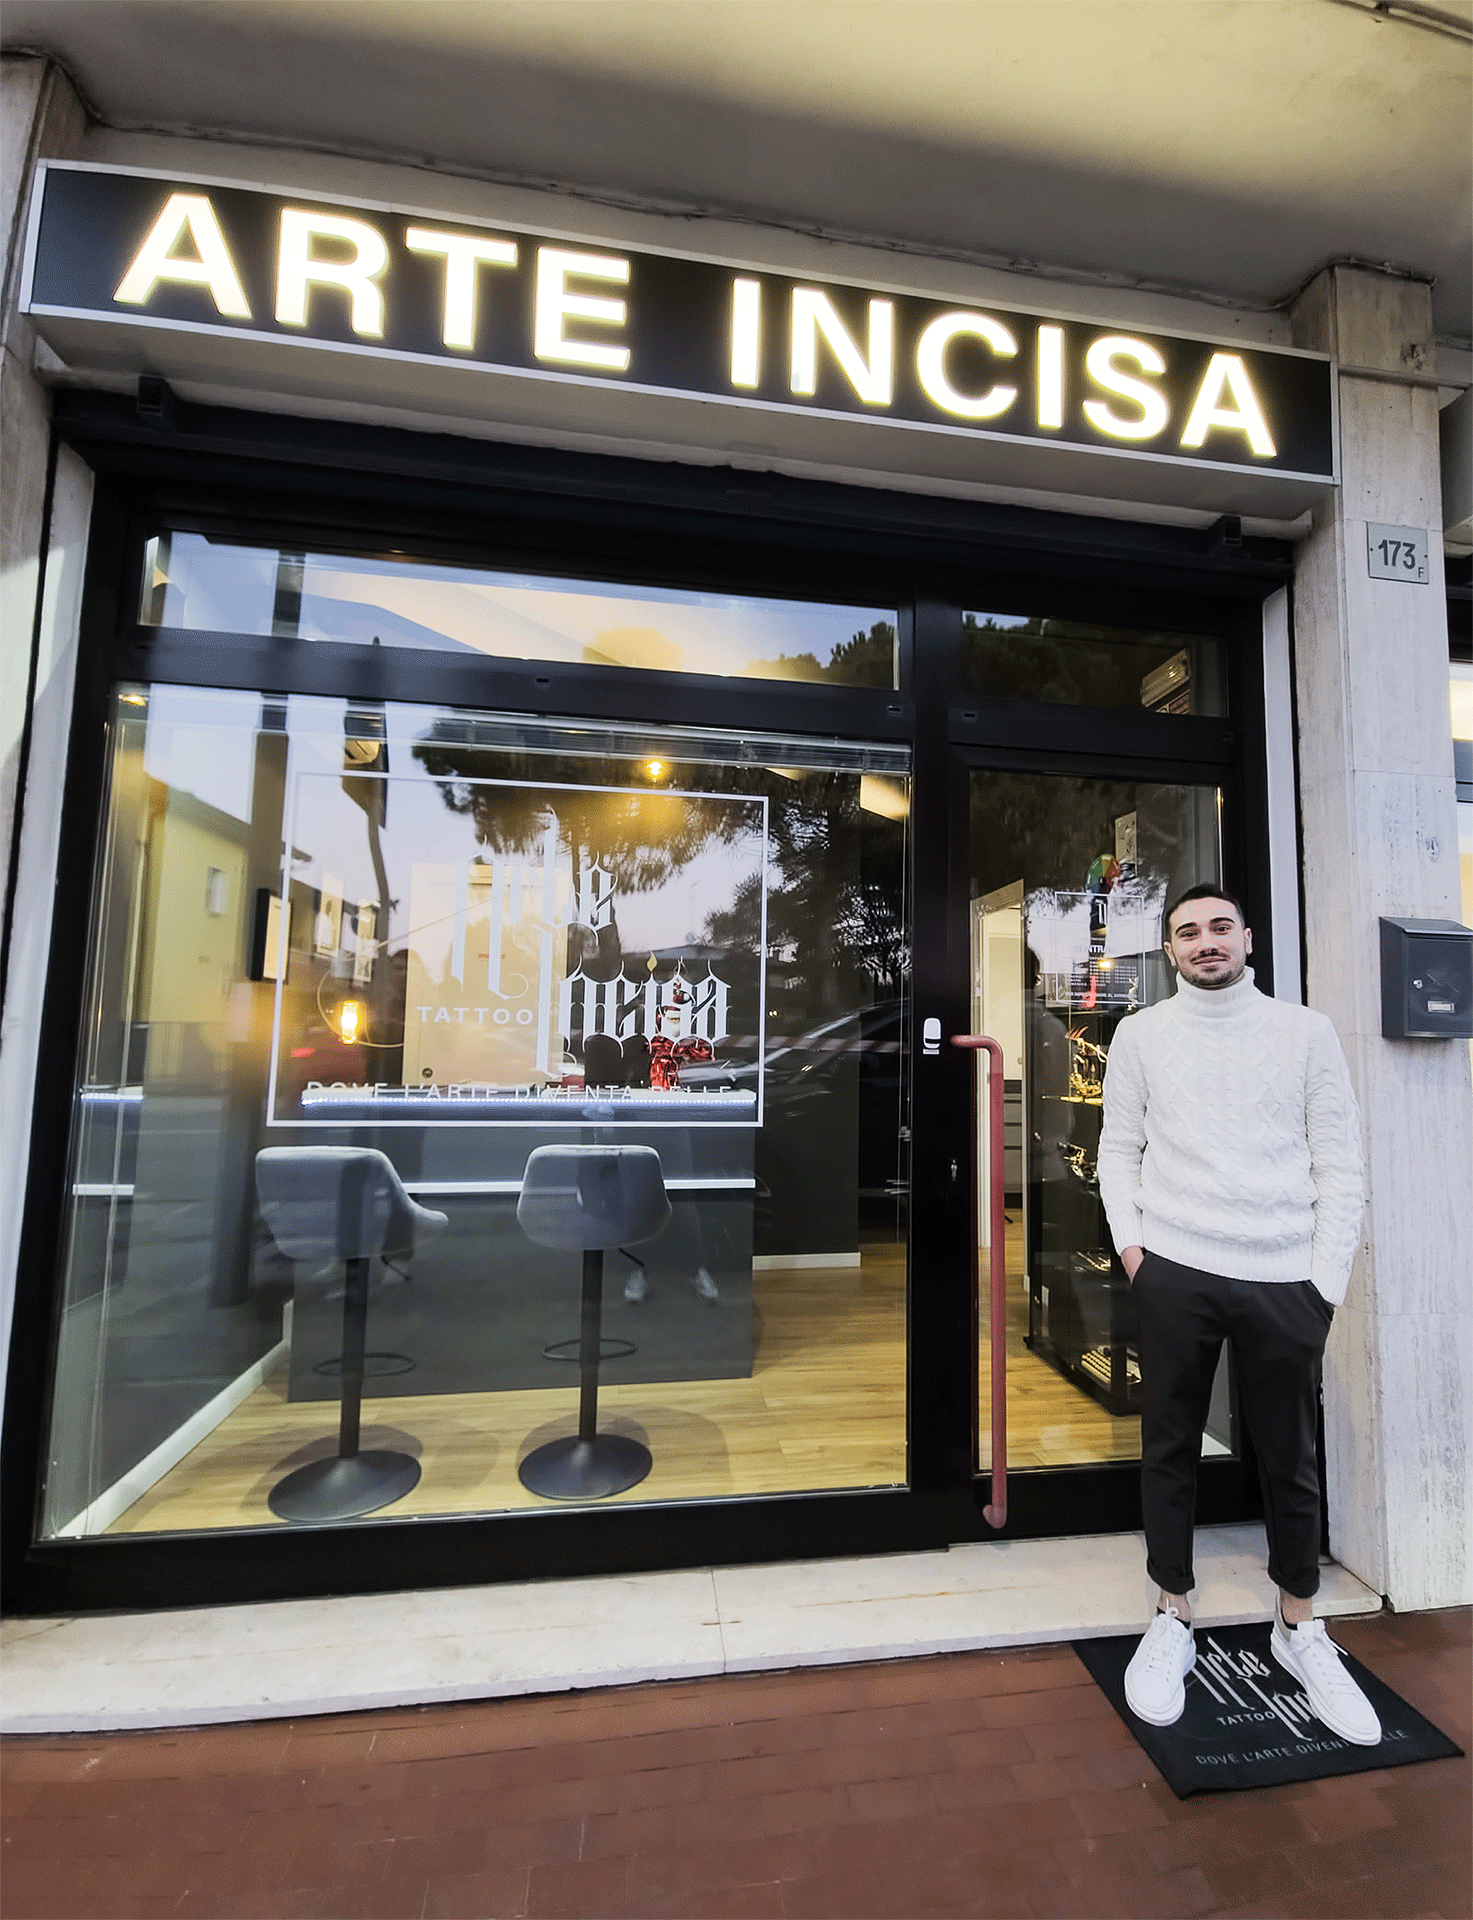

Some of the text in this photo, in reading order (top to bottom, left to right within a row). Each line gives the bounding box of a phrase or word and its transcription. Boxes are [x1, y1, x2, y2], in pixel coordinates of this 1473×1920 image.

[112, 192, 1278, 459] ARTE INCISA
[1378, 539, 1416, 570] 173
[1418, 566, 1425, 579] F
[417, 1005, 534, 1026] TATTOO
[515, 1084, 633, 1100] DIVENTA
[1217, 1711, 1276, 1727] TATTOO
[1195, 1752, 1239, 1766] DOVE
[1242, 1746, 1293, 1763] L'ARTE
[1295, 1738, 1351, 1755] DIVENT
